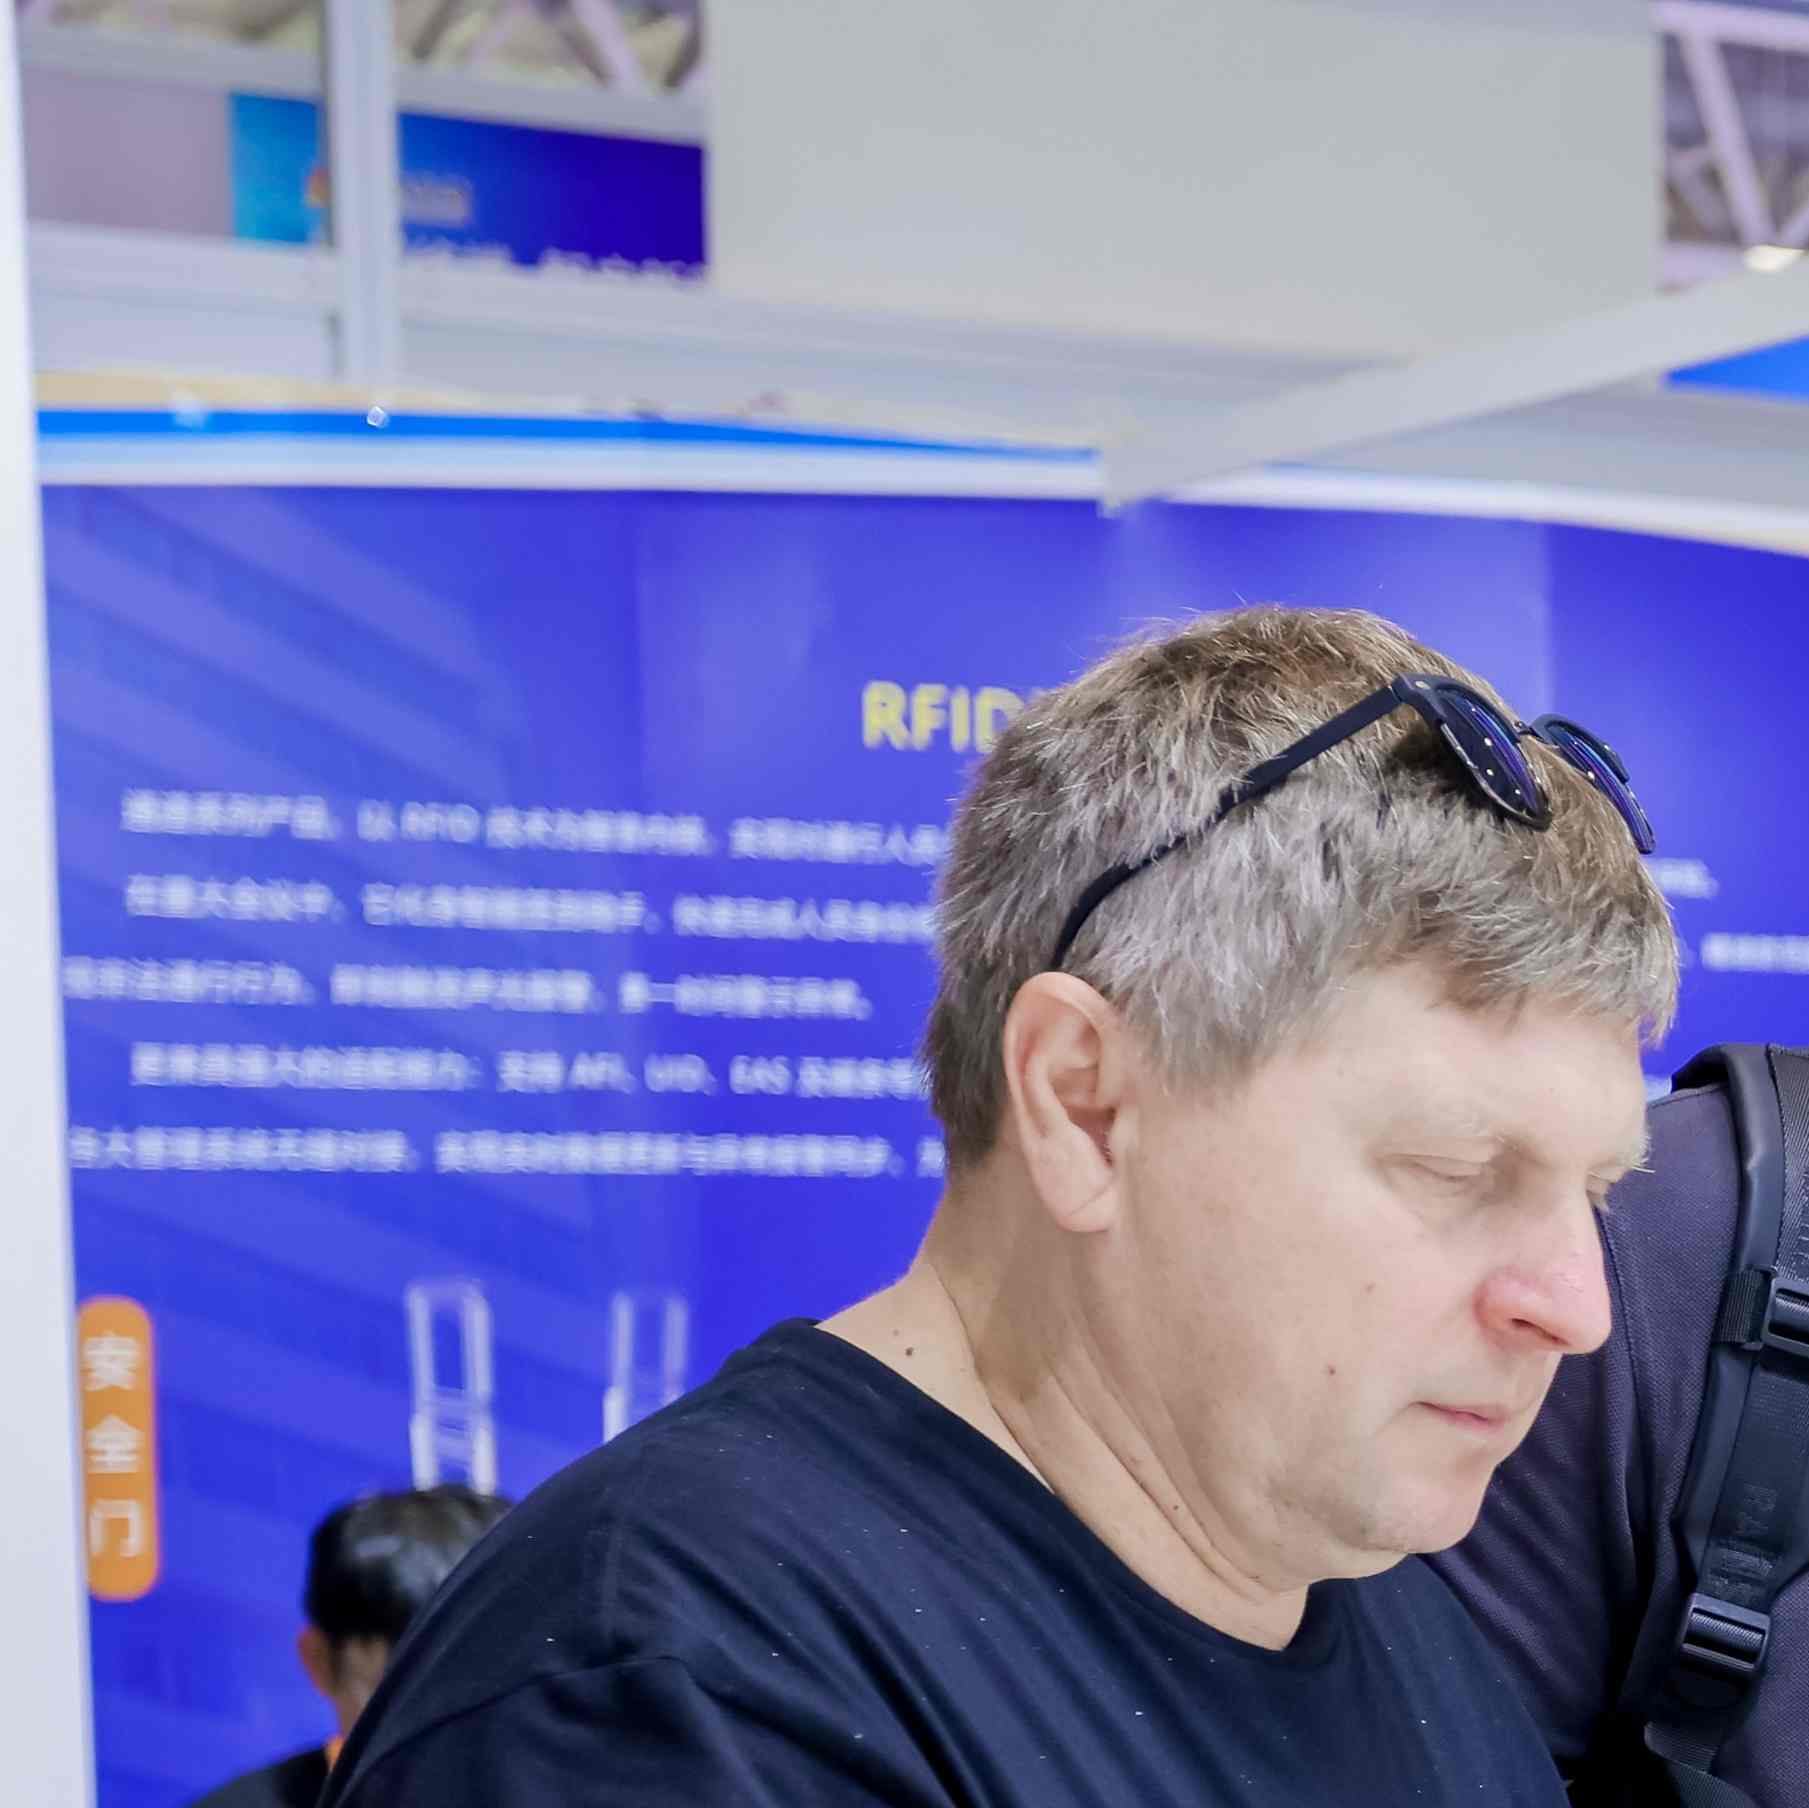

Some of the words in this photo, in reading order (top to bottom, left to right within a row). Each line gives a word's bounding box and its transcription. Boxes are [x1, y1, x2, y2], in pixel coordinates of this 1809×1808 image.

[862, 679, 1026, 754] RFID
[82, 1328, 144, 1560] 安全门
